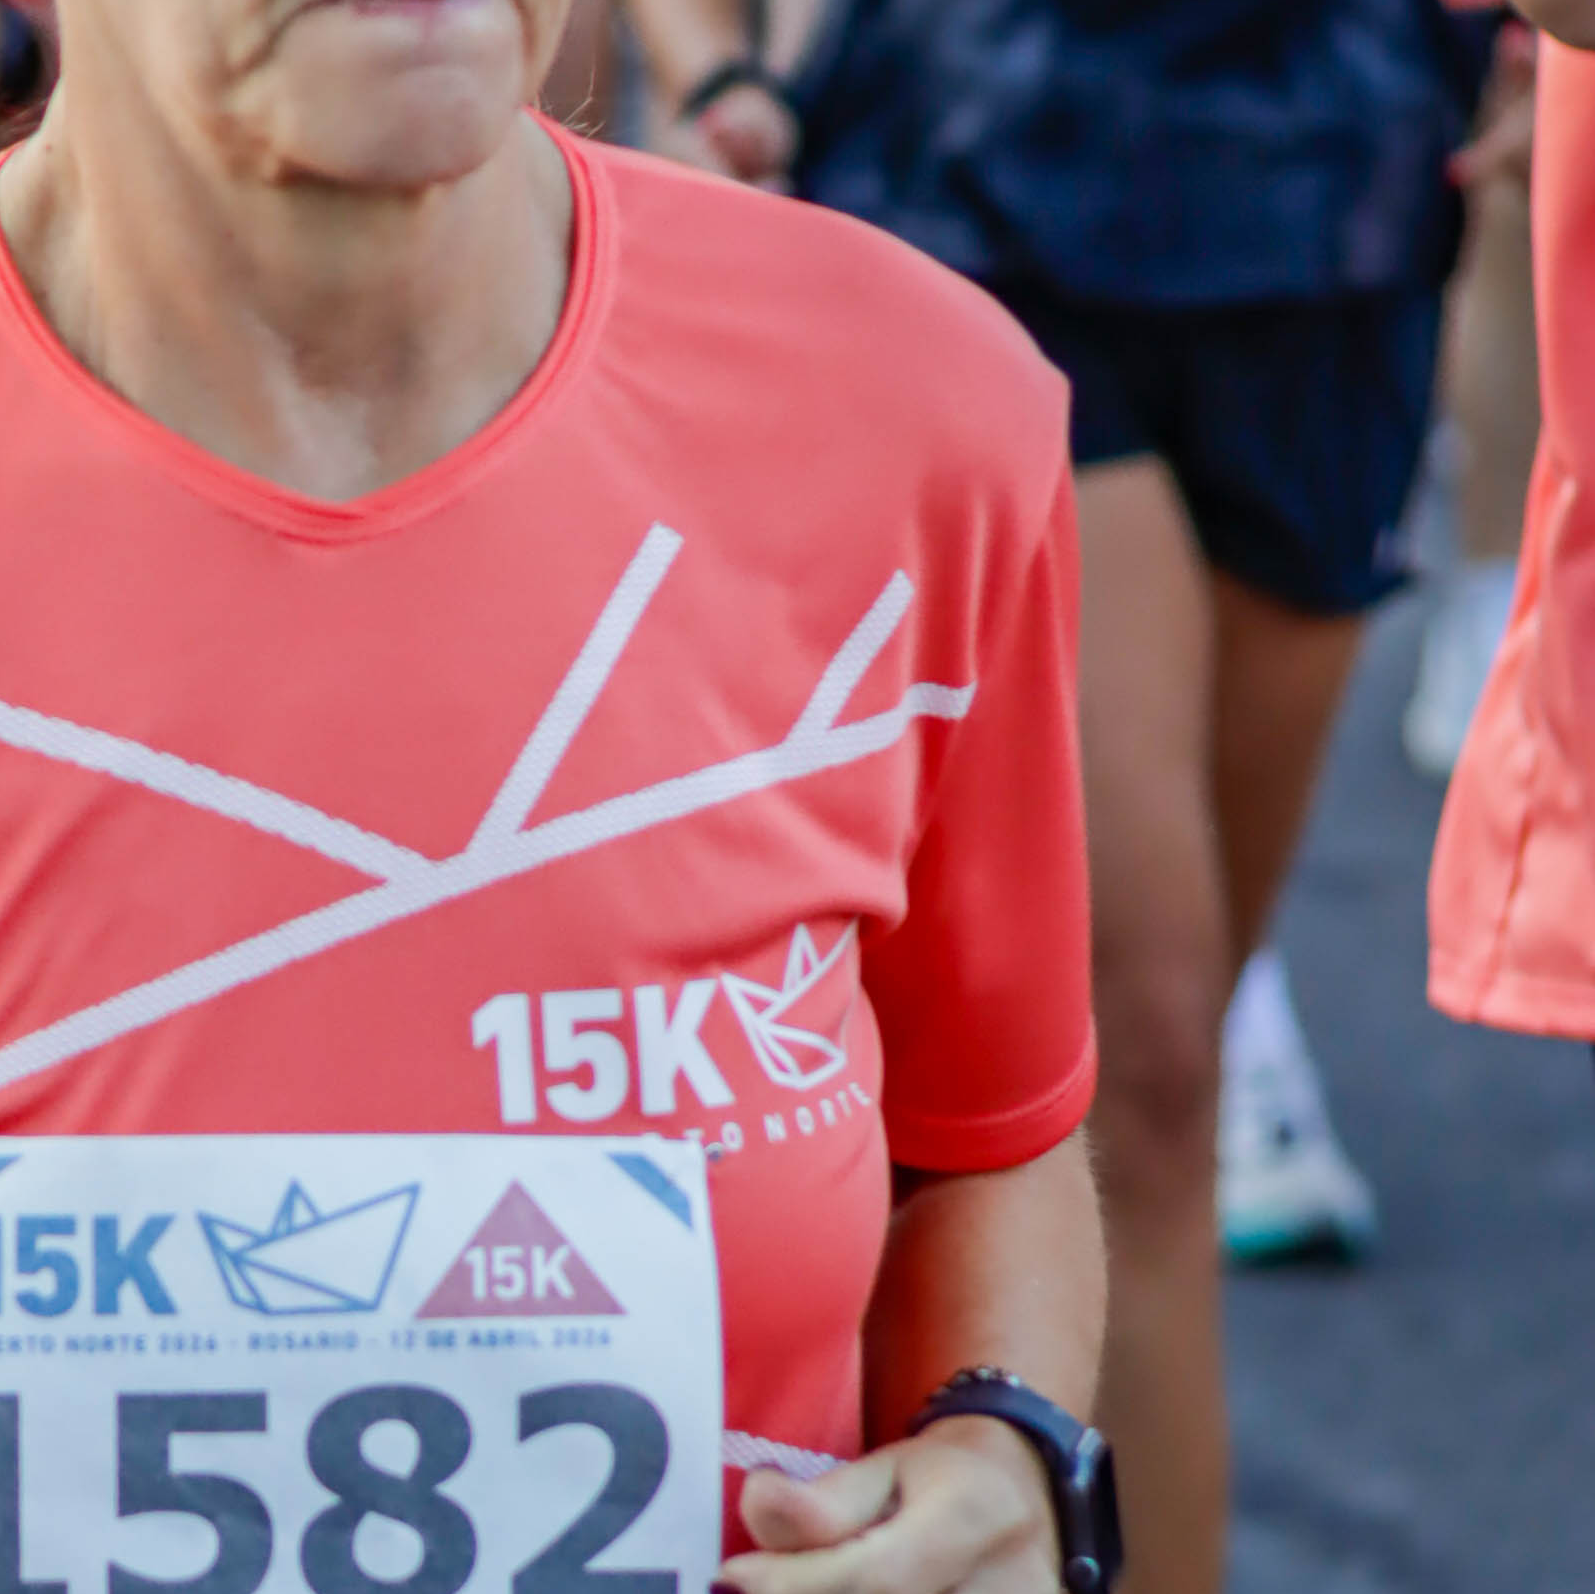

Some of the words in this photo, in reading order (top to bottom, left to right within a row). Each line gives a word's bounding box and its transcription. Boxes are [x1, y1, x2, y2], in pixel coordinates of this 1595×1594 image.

[472, 978, 735, 1123] 15K
[763, 1081, 873, 1144] NORTE
[462, 1245, 575, 1301] 15K
[65, 1331, 148, 1353] NORTE
[248, 1330, 358, 1352] ROSARIO
[426, 1328, 458, 1349] DE
[467, 1327, 543, 1349] ABRIL
